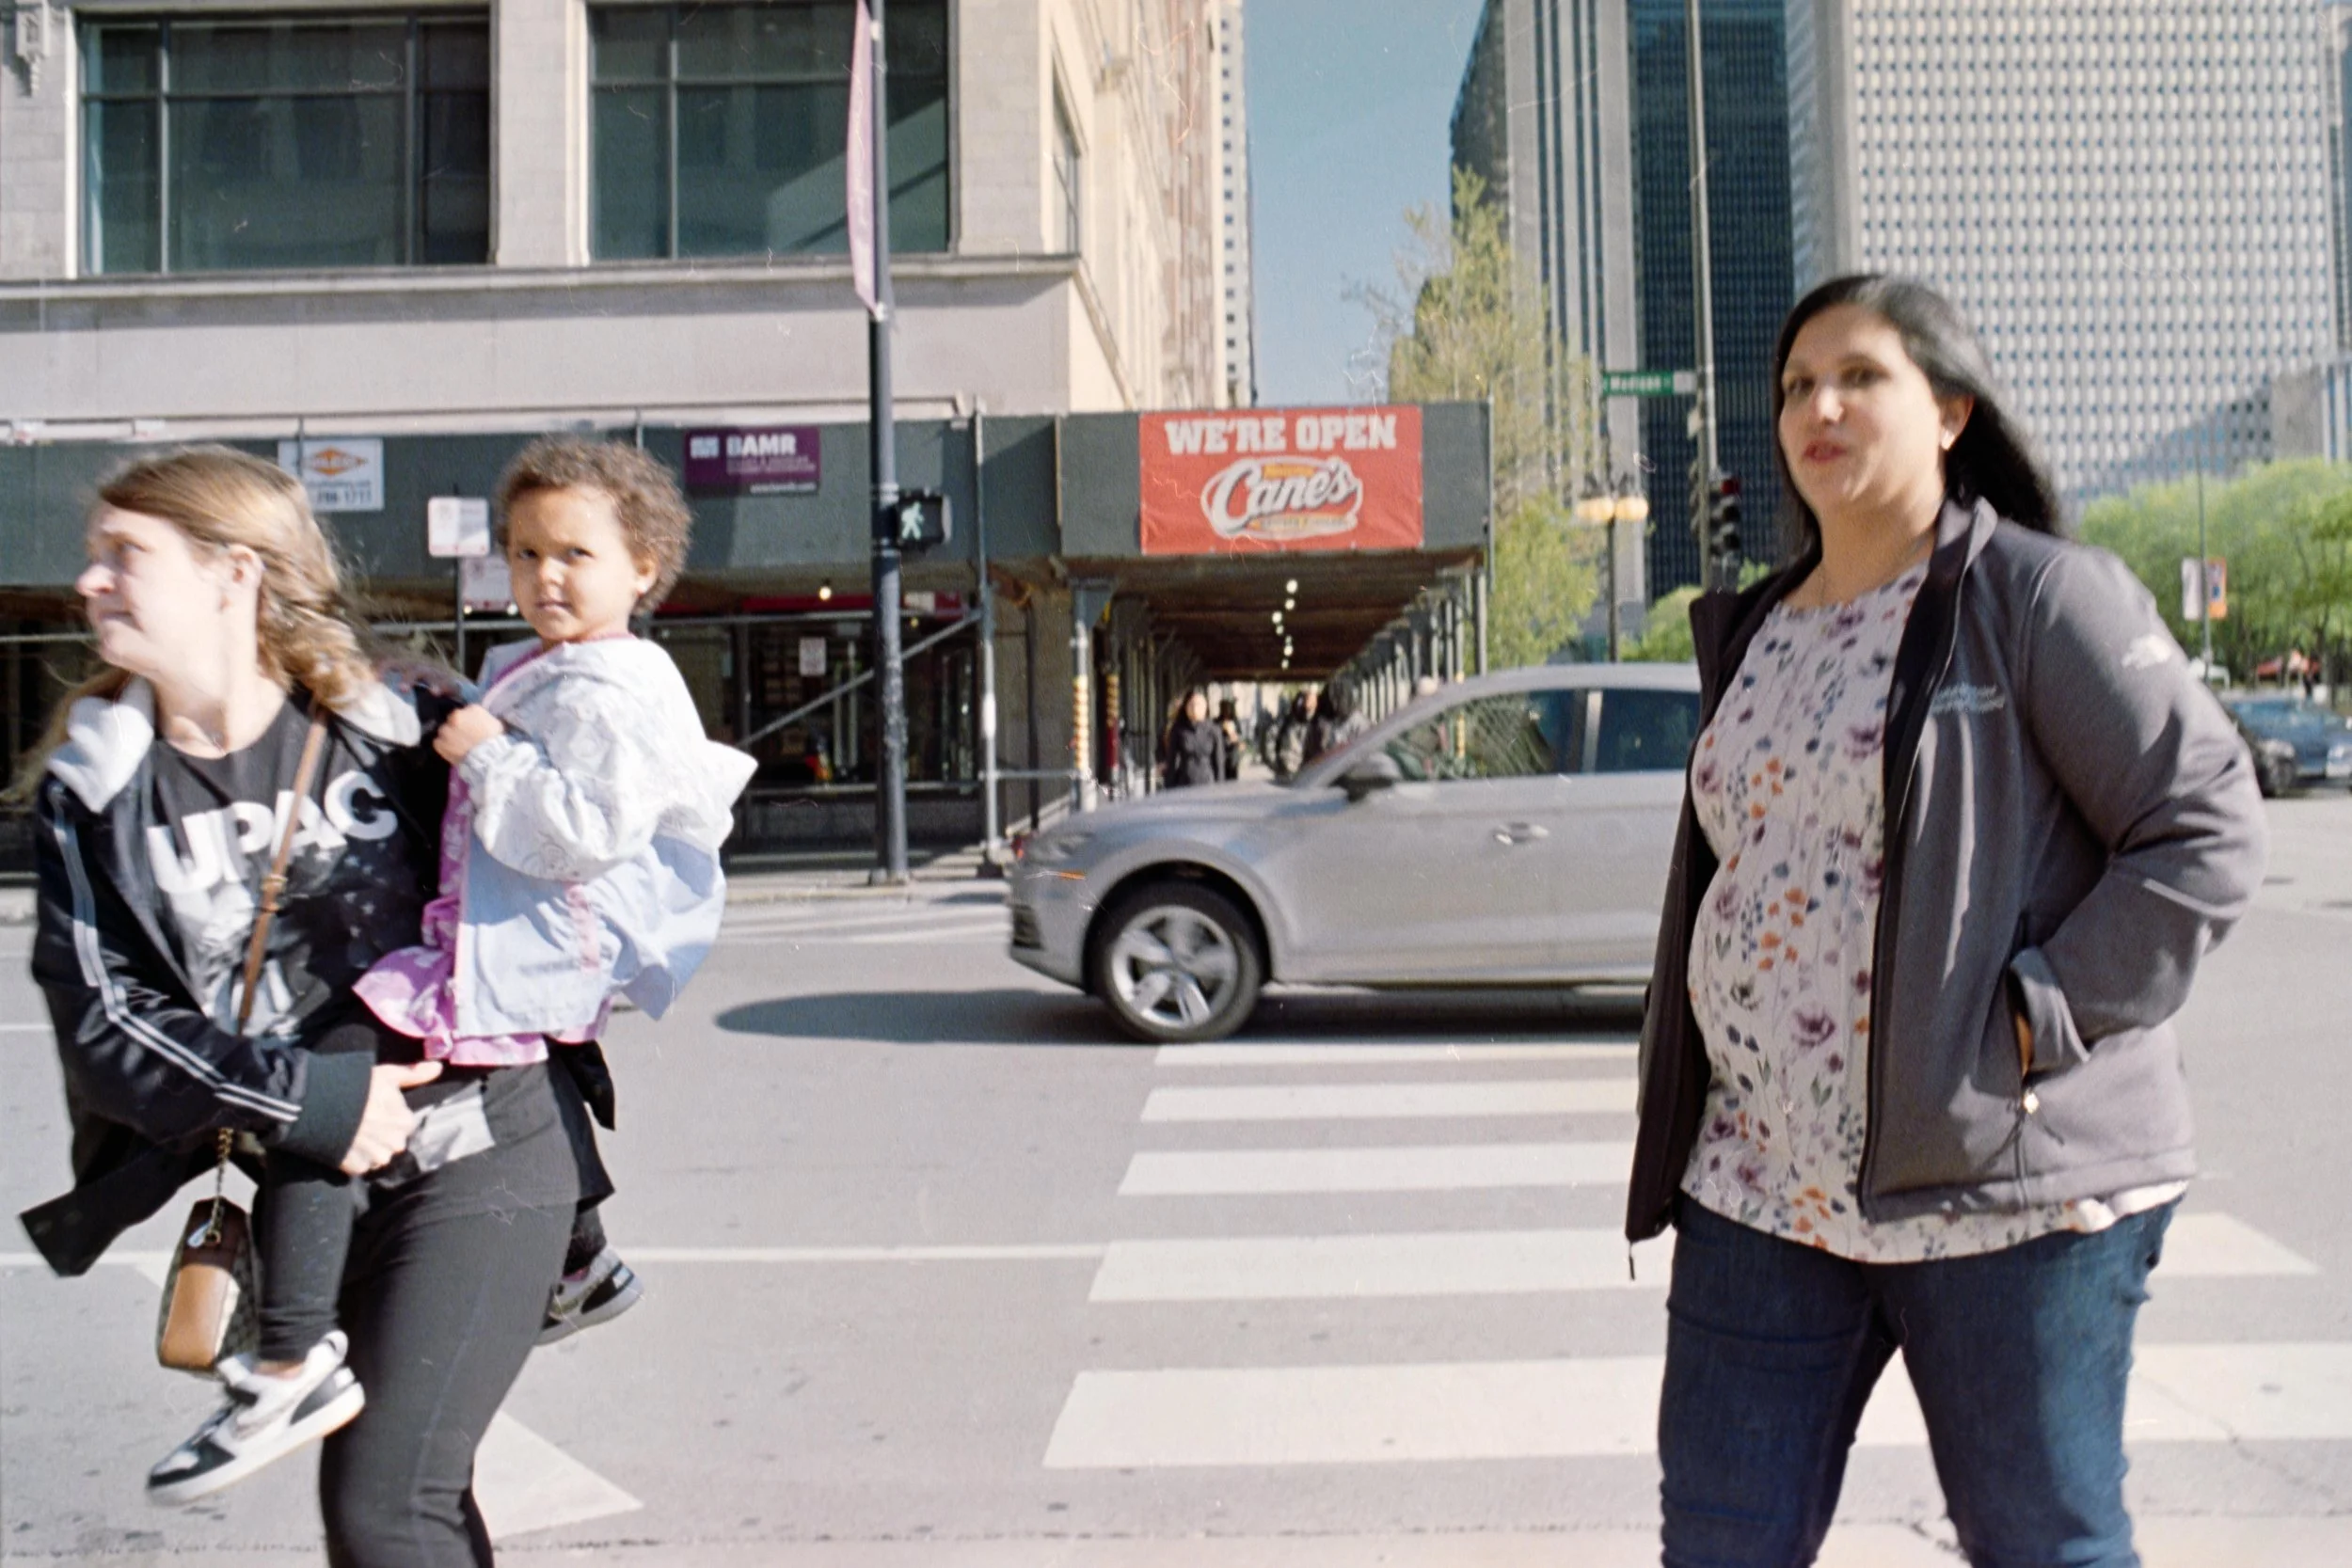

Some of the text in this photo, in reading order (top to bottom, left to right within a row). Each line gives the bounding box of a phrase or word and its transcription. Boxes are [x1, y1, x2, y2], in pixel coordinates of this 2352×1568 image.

[1164, 414, 1398, 454] WE'RE OPEN
[1211, 455, 1360, 533] Cane's
